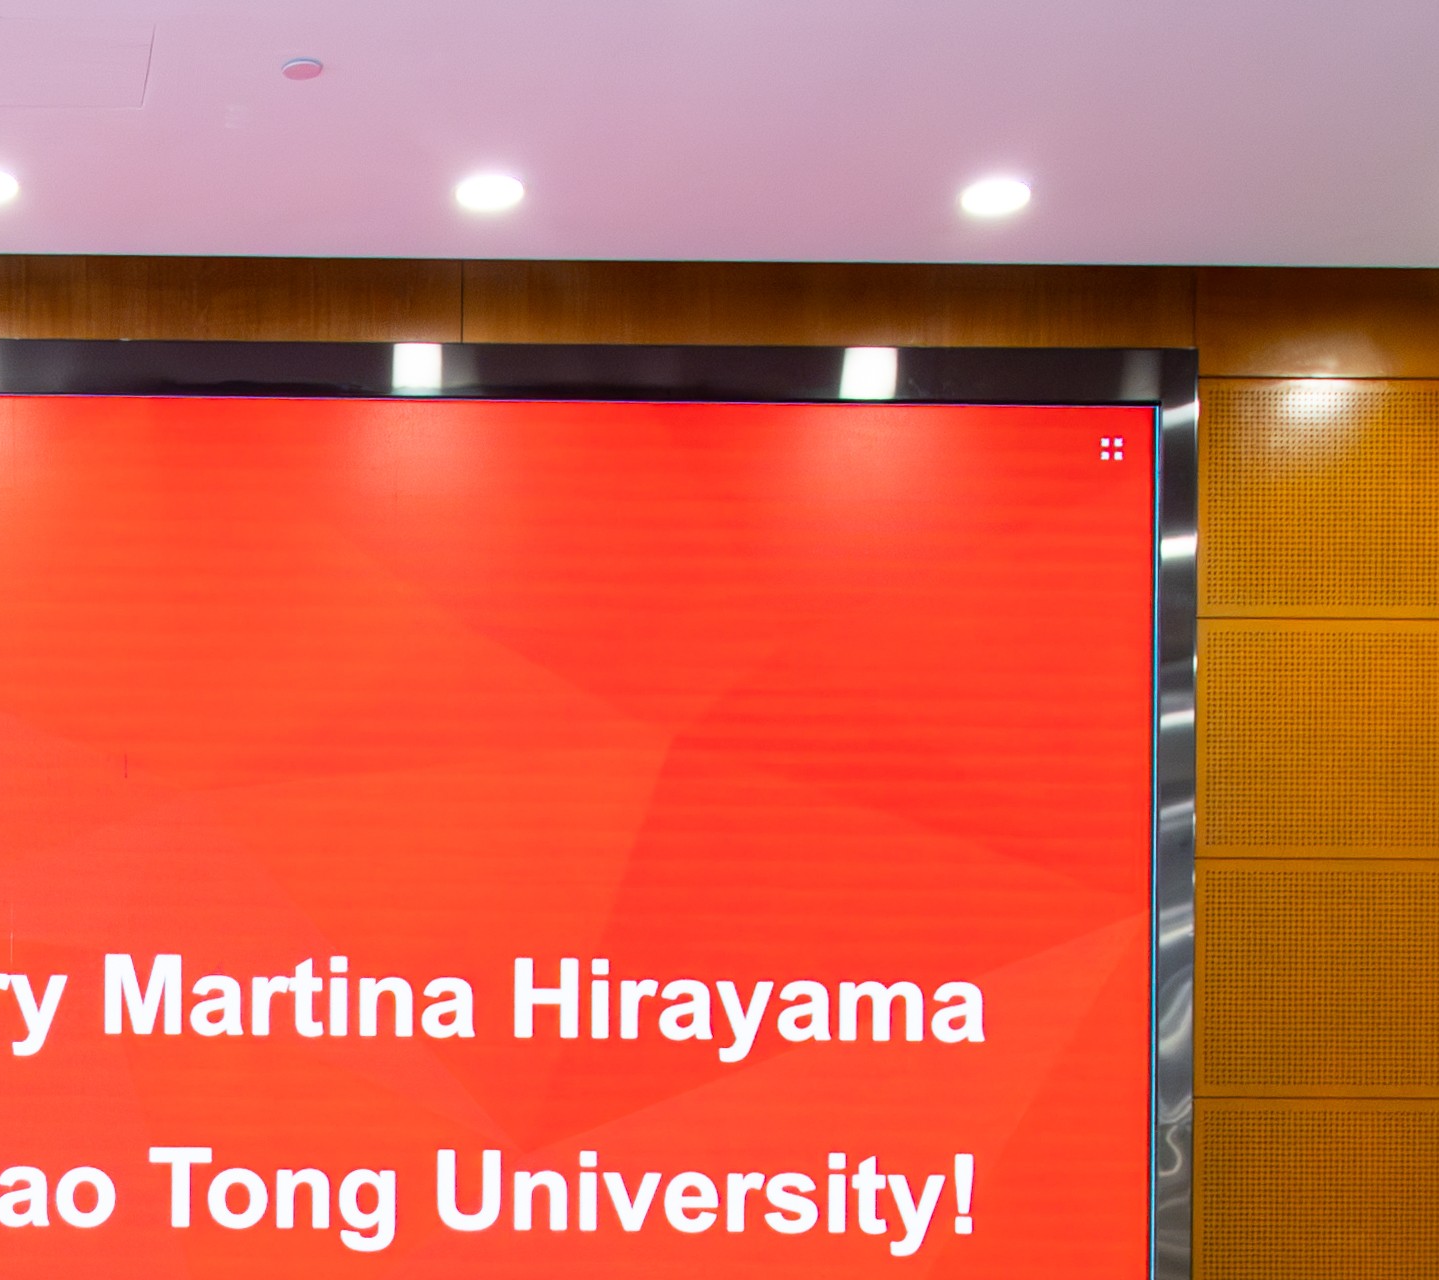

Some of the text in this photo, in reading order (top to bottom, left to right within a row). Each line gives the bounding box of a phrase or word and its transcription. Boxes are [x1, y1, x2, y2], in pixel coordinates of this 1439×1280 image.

[103, 953, 476, 1039] Martina
[513, 957, 986, 1063] Hirayama
[148, 1146, 396, 1253] Tong
[436, 1149, 974, 1257] University!
